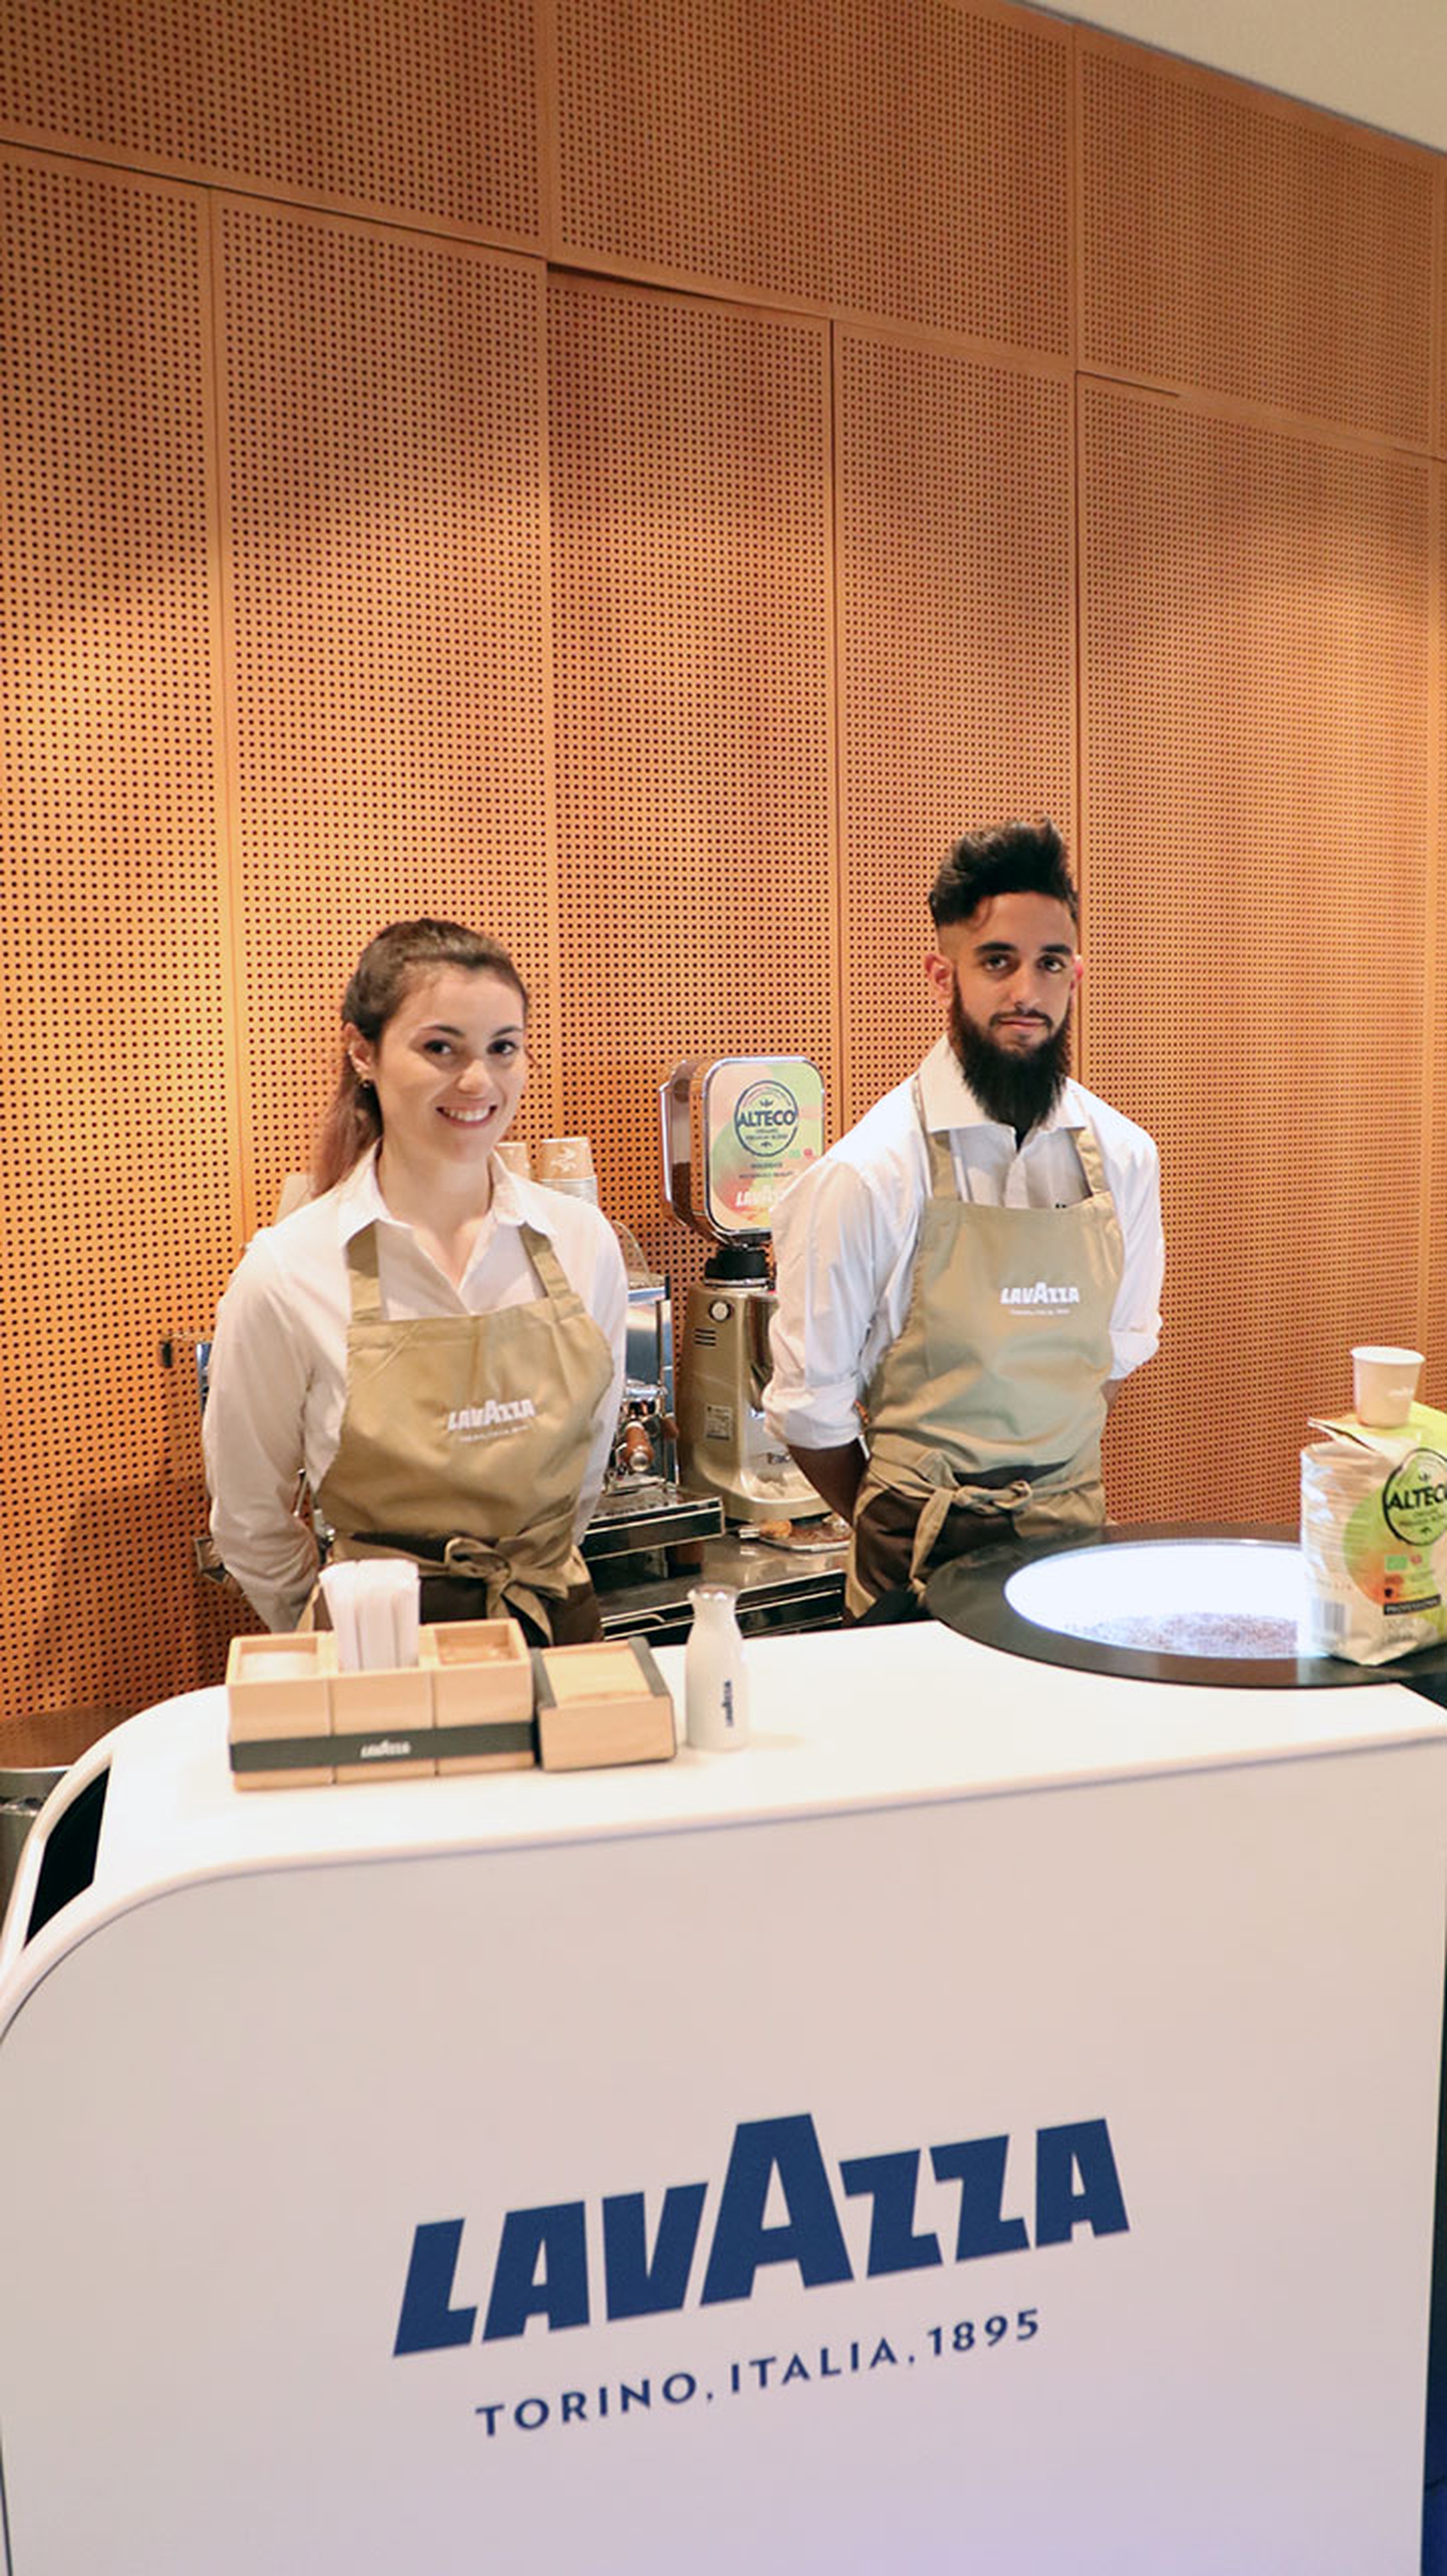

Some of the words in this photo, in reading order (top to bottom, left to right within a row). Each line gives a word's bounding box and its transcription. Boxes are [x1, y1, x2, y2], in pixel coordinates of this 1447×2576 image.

[737, 1110, 796, 1127] ALTECO
[1000, 1281, 1079, 1304] LAVAZZA
[448, 1400, 535, 1431] LAVAZZA
[1387, 1483, 1447, 1510] ALTEC
[393, 2113, 1130, 2357] LAVAZZA
[476, 2373, 713, 2437] TORINO,
[731, 2338, 915, 2394] ITALIA,
[928, 2308, 1039, 2357] 1895
